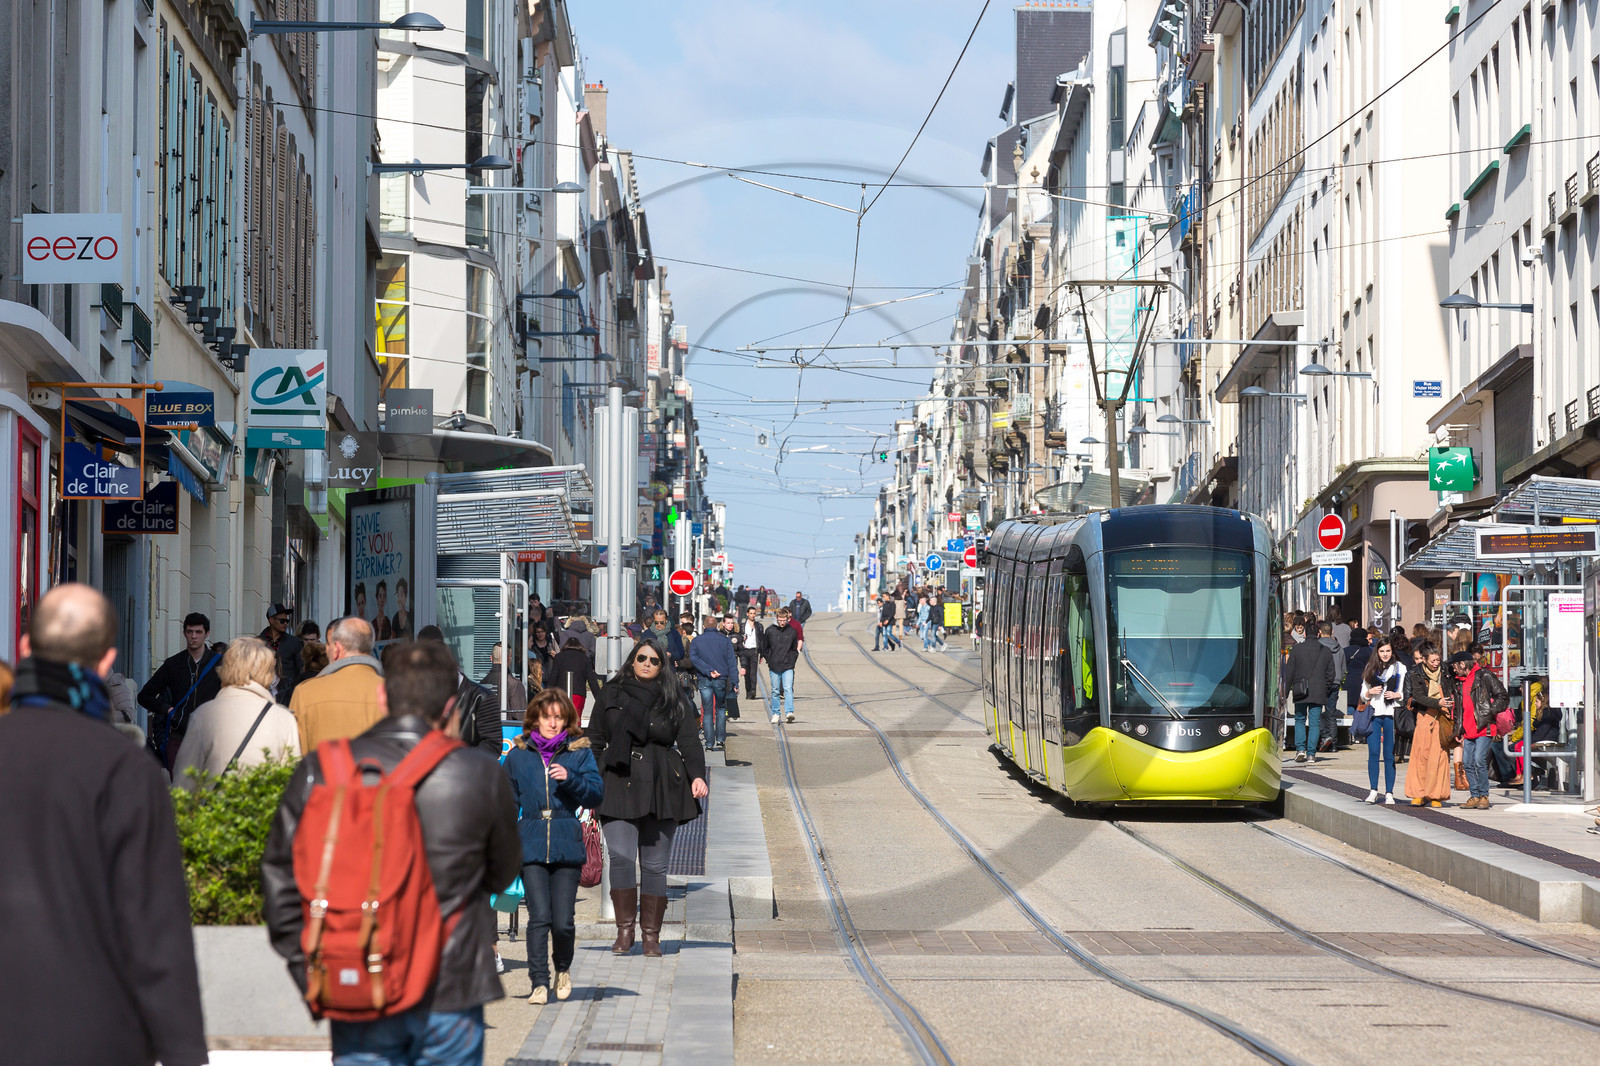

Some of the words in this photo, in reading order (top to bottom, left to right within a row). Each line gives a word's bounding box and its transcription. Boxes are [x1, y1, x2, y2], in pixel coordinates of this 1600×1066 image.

[27, 236, 118, 260] eezo
[149, 404, 182, 413] BLUE
[186, 403, 213, 413] BOX
[391, 404, 428, 417] pimkie
[83, 462, 119, 478] Clair
[67, 478, 88, 494] de
[94, 478, 129, 494] lune
[131, 500, 165, 515] Clair
[117, 515, 136, 529] de
[142, 515, 174, 530] lune
[356, 512, 381, 536] ENVIE
[355, 536, 366, 558] DE
[368, 531, 394, 555] VOUS
[516, 551, 542, 561] range
[355, 553, 395, 580] EXPRIMER
[1166, 724, 1202, 736] bbus
